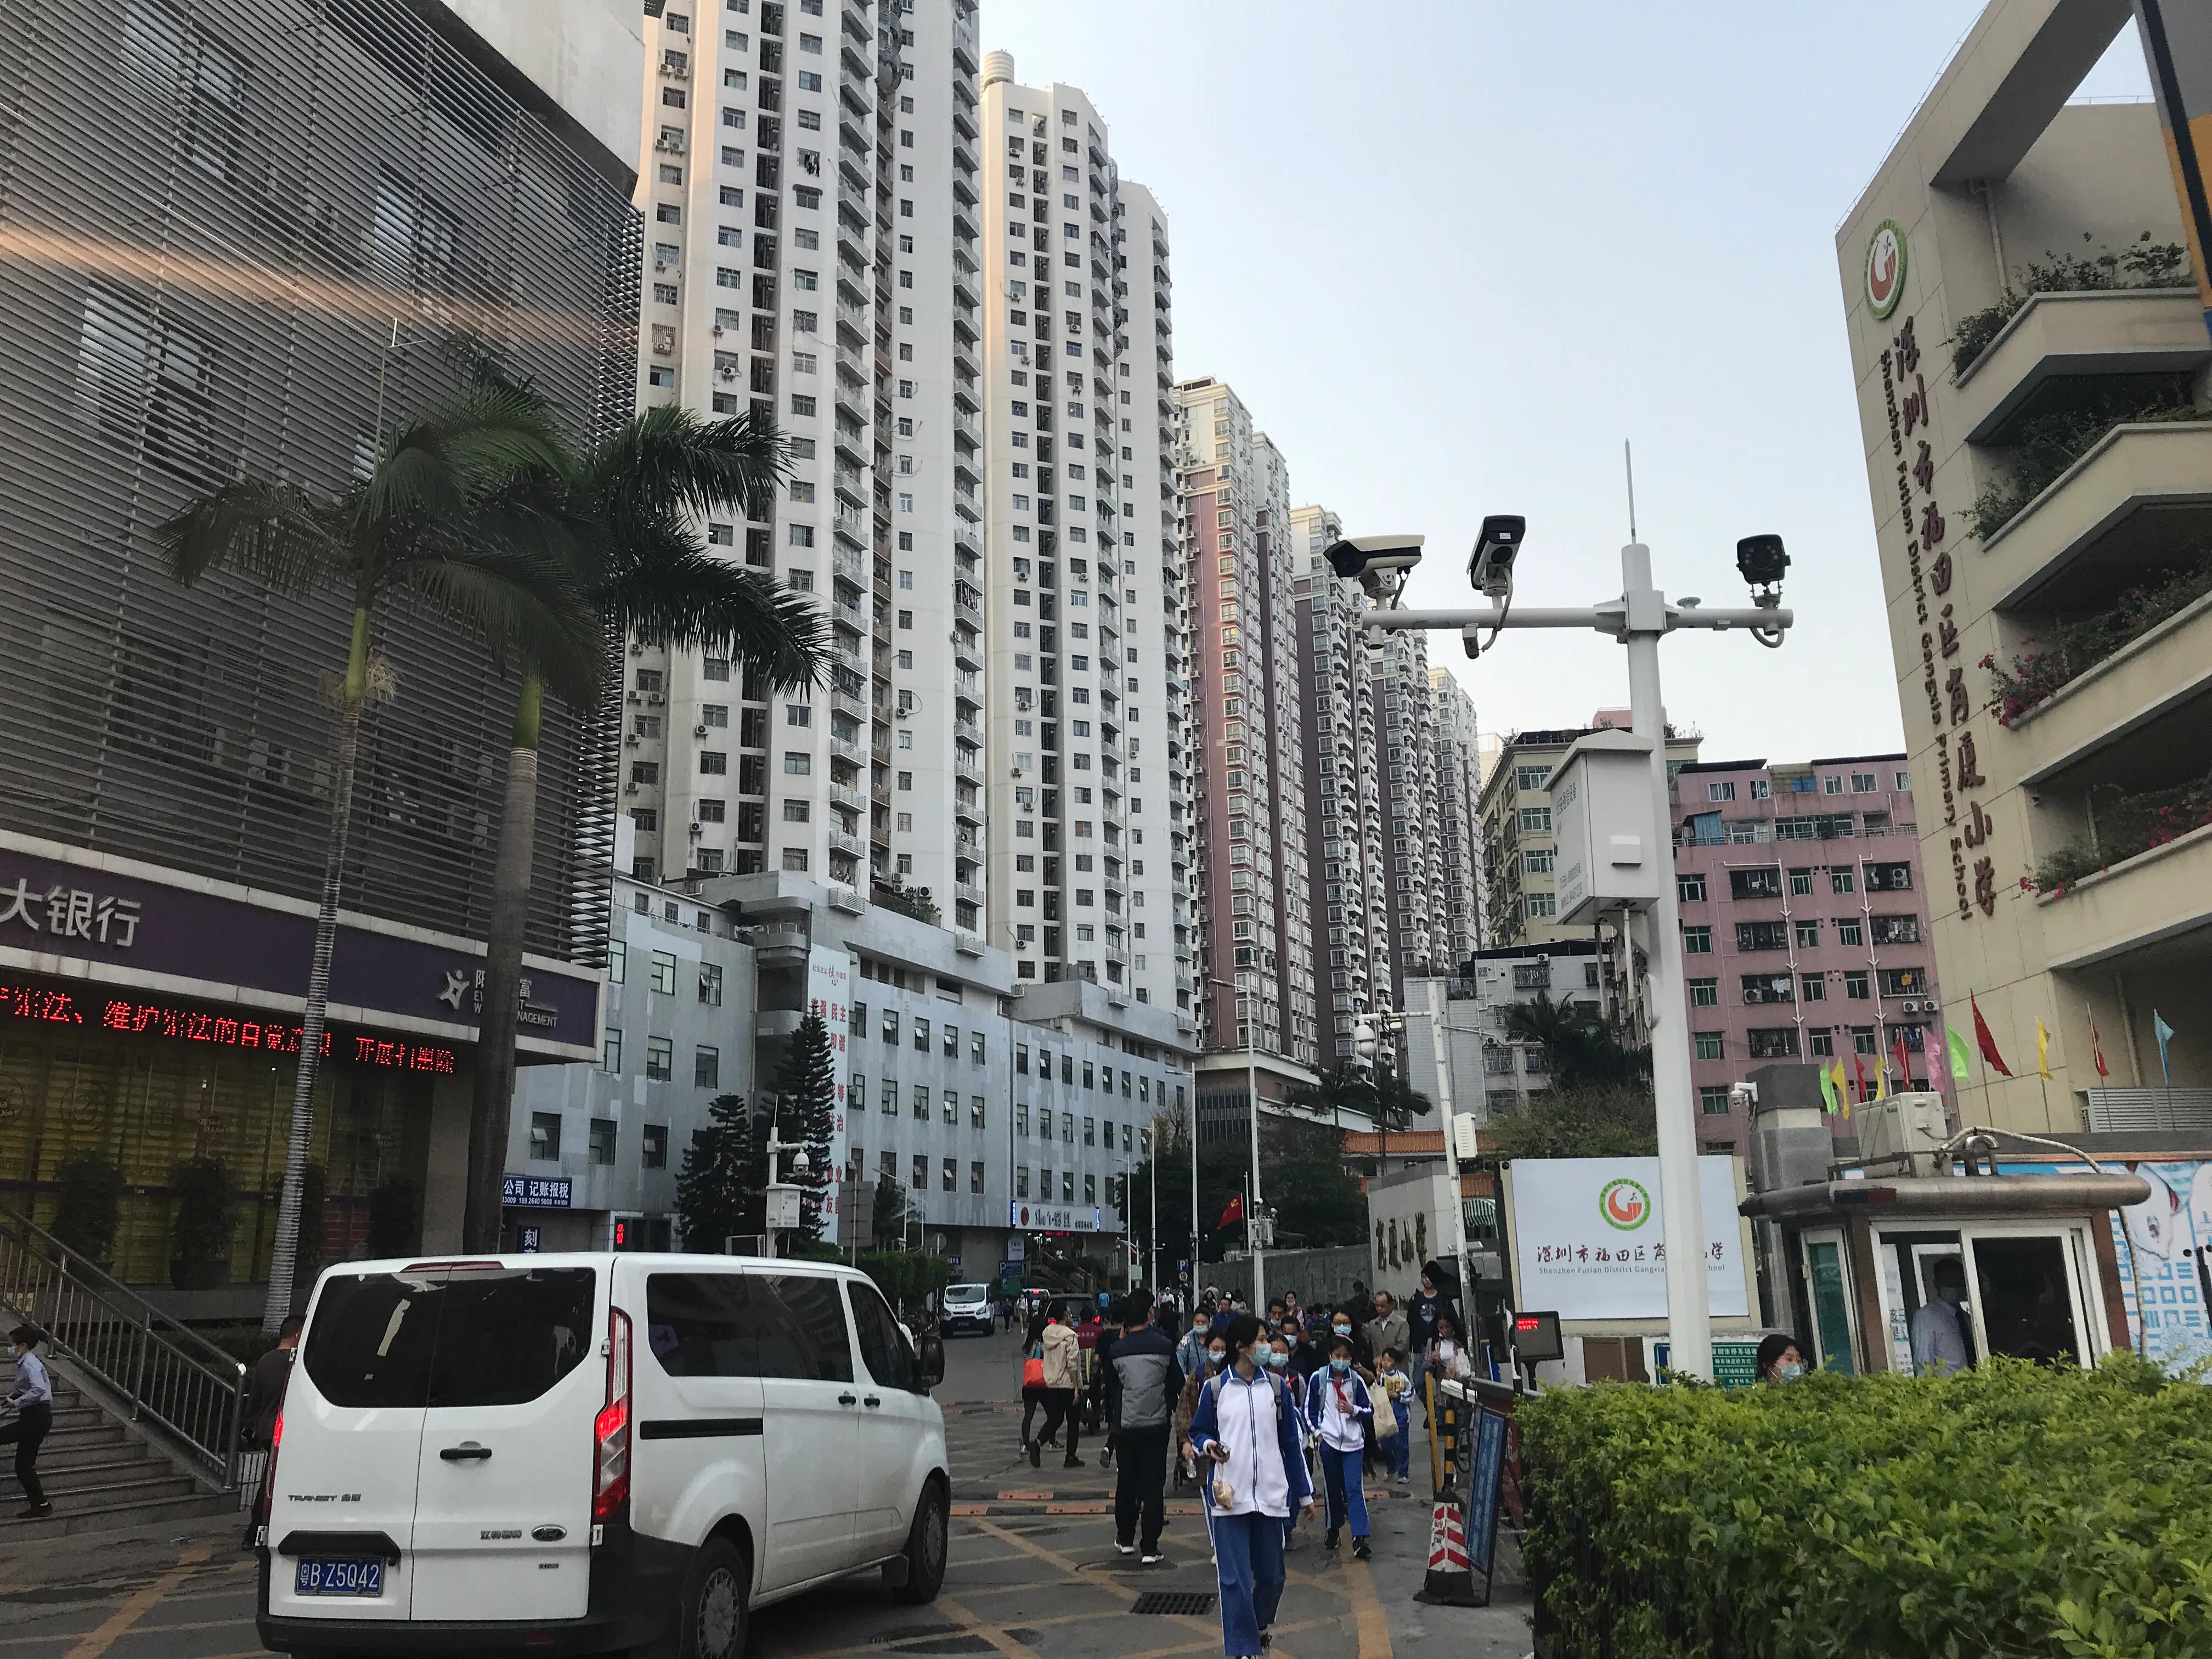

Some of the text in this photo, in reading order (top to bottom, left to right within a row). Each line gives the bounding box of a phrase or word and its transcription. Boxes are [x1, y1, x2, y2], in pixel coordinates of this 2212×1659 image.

[1880, 348, 1903, 457] Shenzhen
[1896, 460, 1914, 534] Futian
[1908, 539, 1927, 625] District
[1921, 632, 1942, 725] Gangxia
[1936, 732, 1957, 827] Primary
[1893, 315, 1997, 917] 深圳市福田区岗厦小学
[0, 877, 141, 947] 大银行
[517, 1011, 558, 1028] NAGEMENT
[831, 1002, 847, 1023] 民主
[830, 1031, 846, 1052] 和谐
[504, 1179, 569, 1198] 公司 记账报税
[1537, 1242, 1723, 1263] 深圳市福田区岗学
[1000, 1262, 1006, 1274] P
[1180, 1260, 1186, 1270] P
